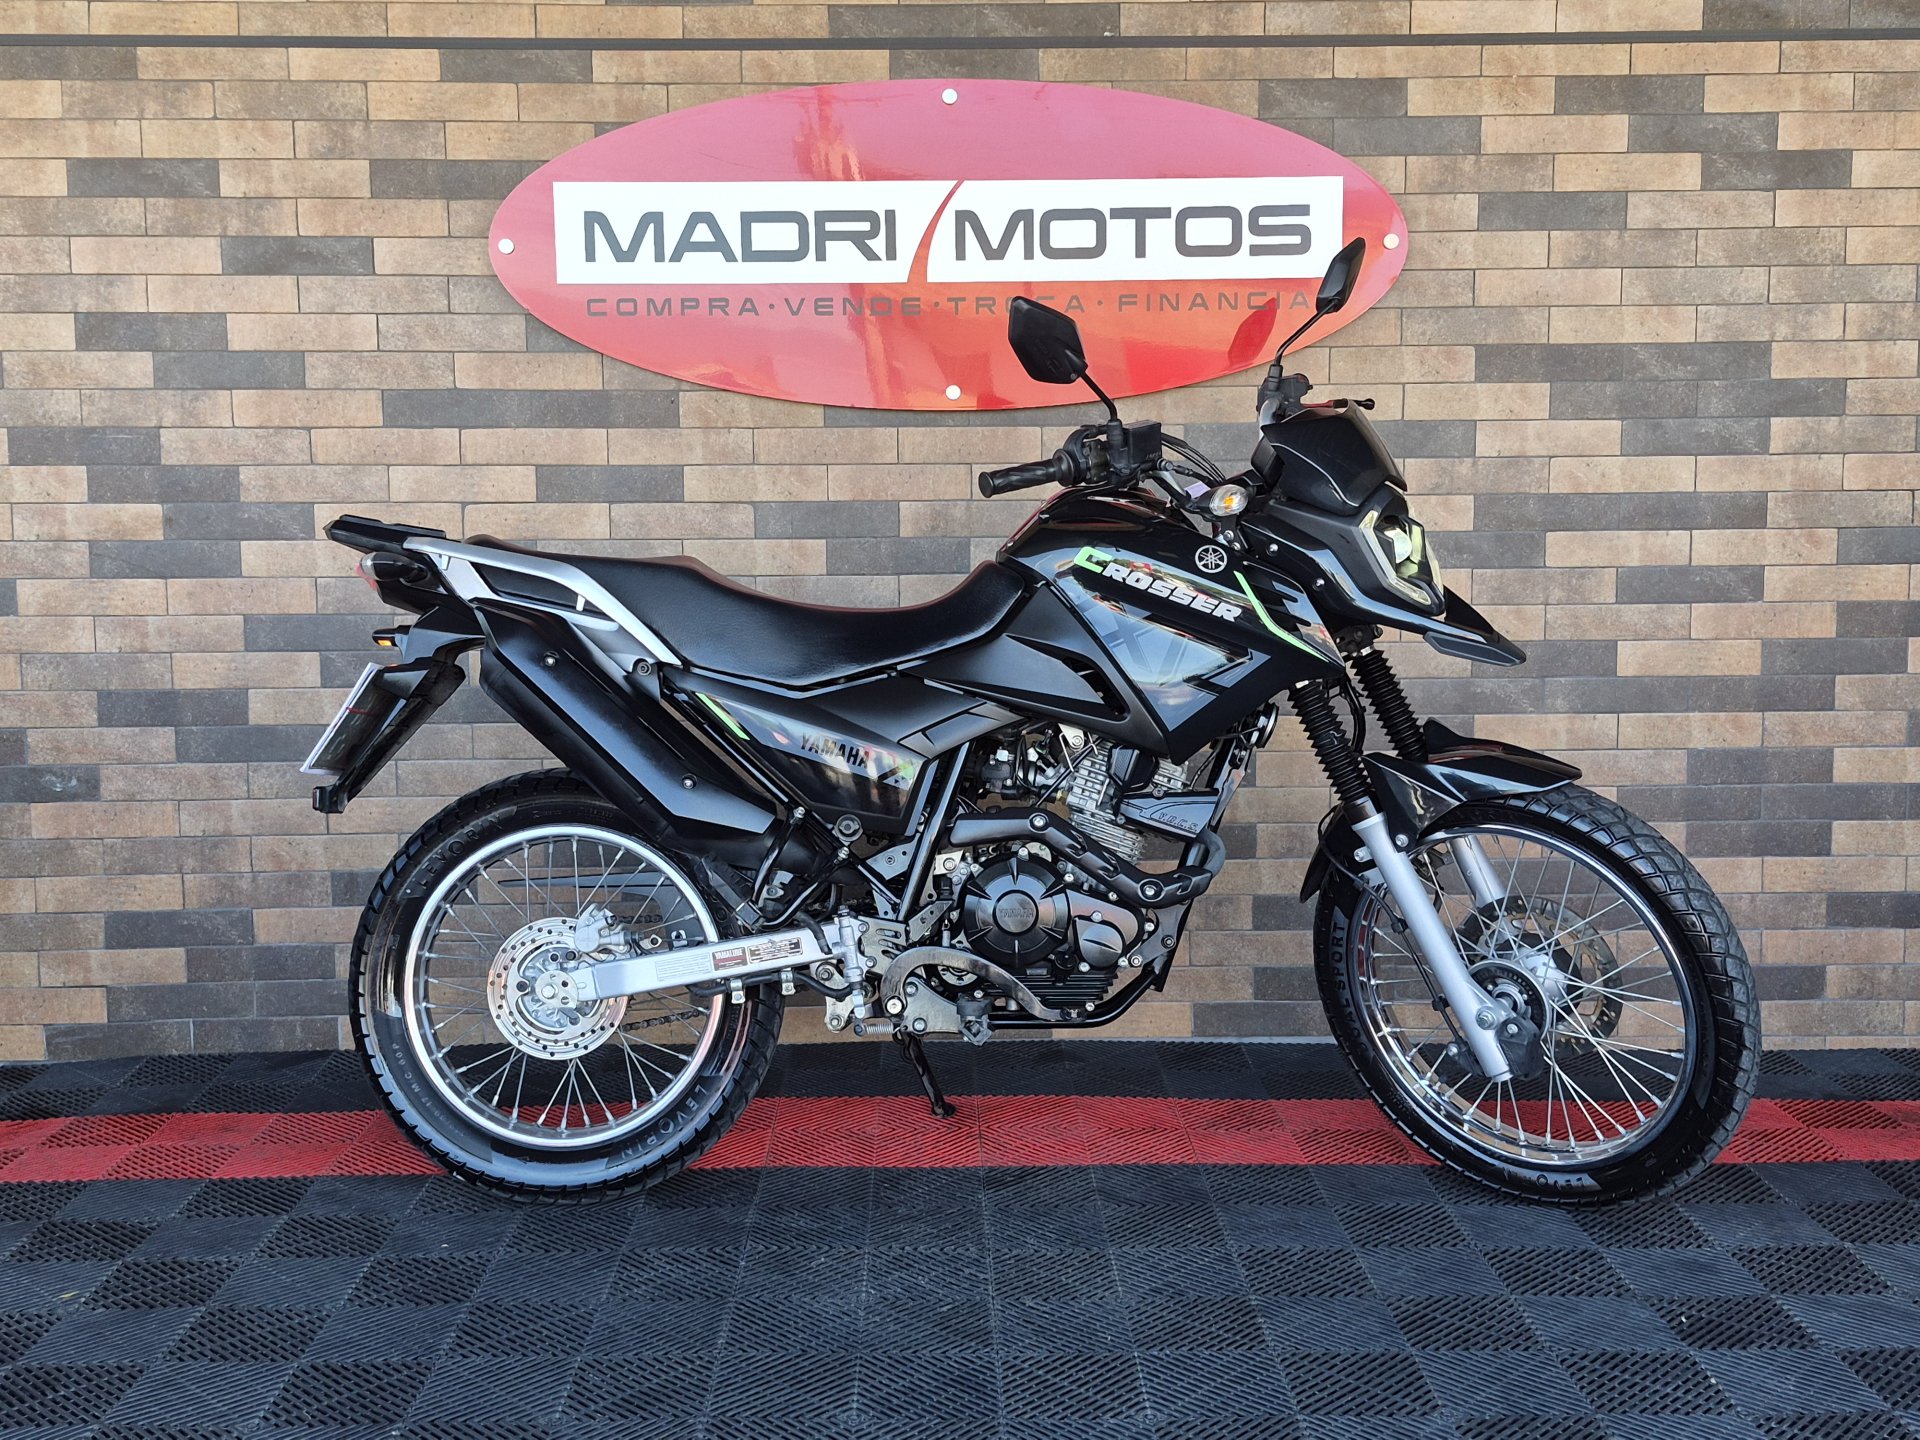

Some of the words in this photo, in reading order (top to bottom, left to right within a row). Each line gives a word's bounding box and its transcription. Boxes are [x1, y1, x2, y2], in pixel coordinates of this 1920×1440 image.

[584, 210, 896, 263] MADRI
[955, 204, 1312, 260] MOTOS
[586, 298, 760, 317] COMPRA
[784, 297, 921, 317] VENDE
[947, 295, 1085, 315] TRA
[1118, 291, 1311, 312] FINANCIA
[1073, 546, 1243, 622] CROSSER
[800, 732, 869, 769] YAMAHA
[1332, 922, 1346, 991] SPORT
